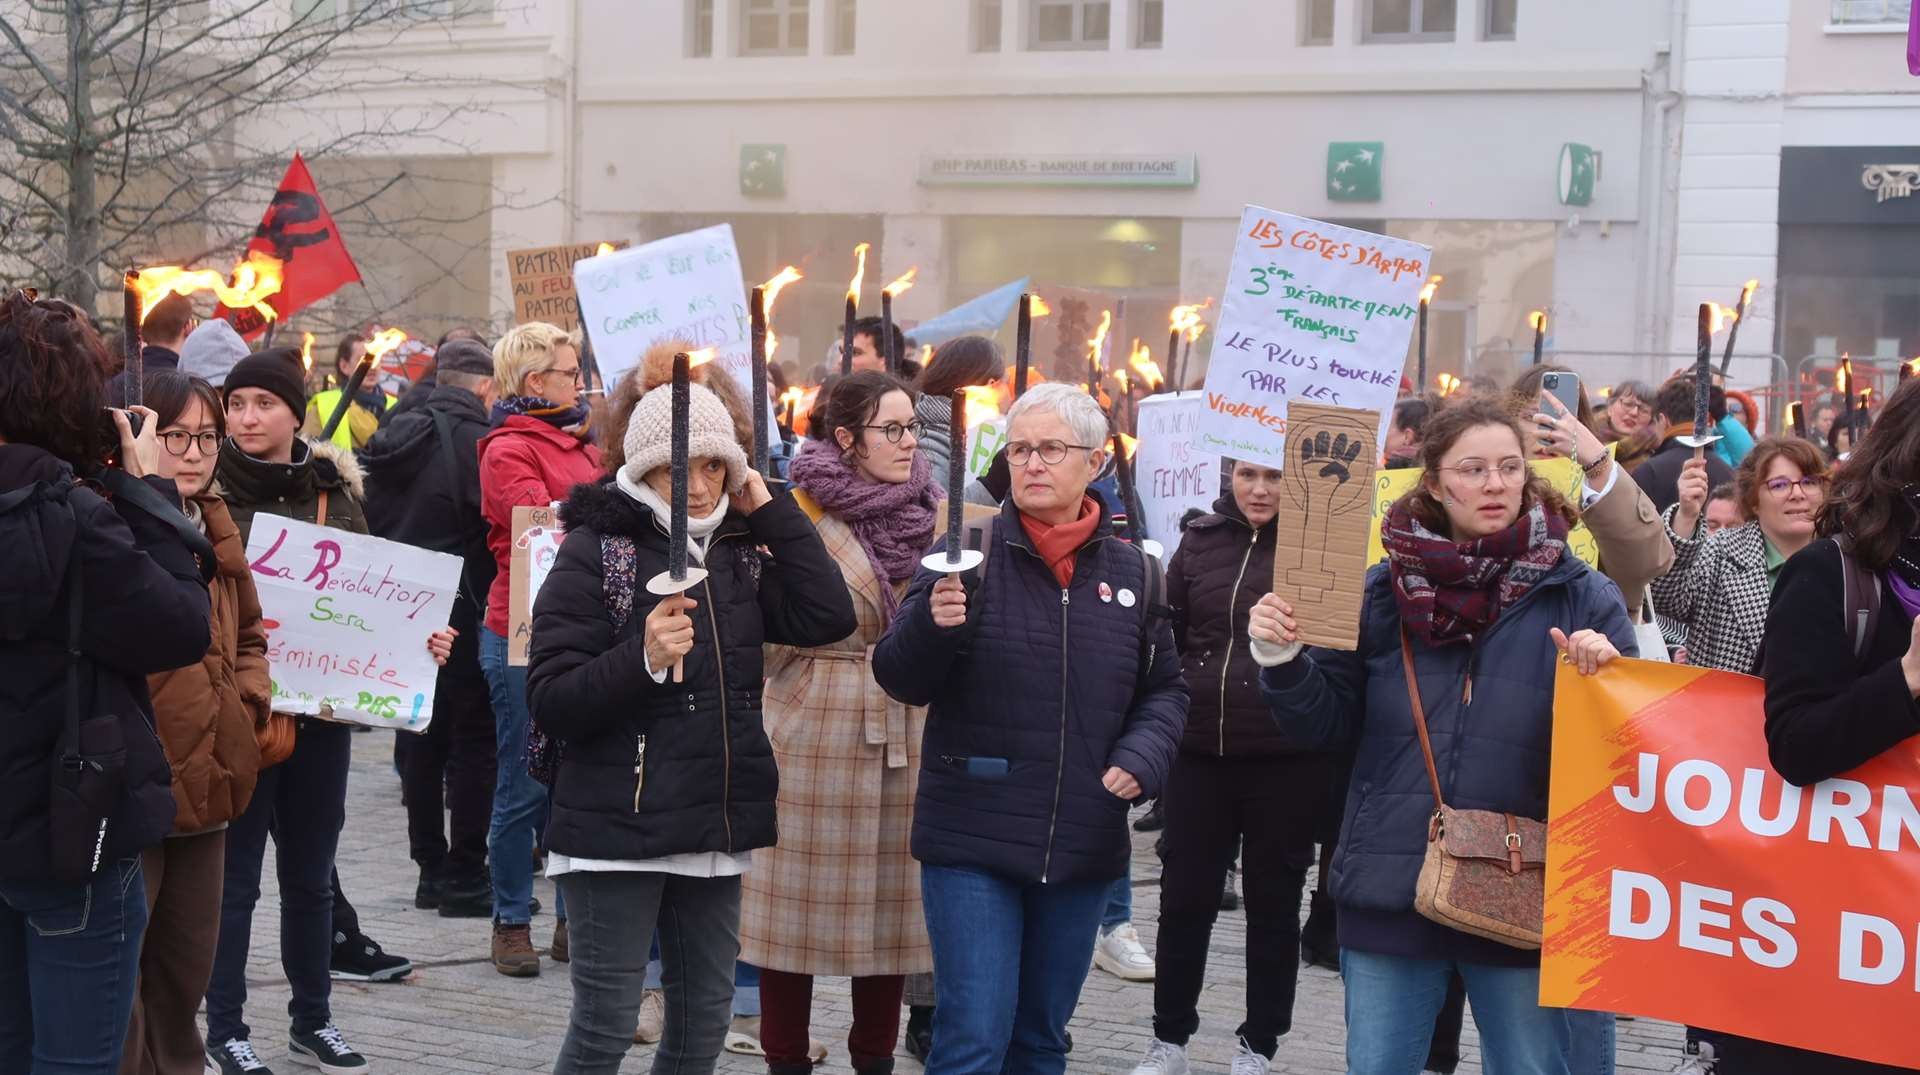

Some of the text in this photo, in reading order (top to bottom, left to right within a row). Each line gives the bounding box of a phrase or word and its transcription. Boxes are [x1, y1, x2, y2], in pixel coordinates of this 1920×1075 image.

[932, 159, 961, 172] BNP
[964, 159, 1027, 171] PARIBAS
[1040, 160, 1088, 172] BANQUE
[1093, 160, 1107, 171] DE
[1111, 160, 1177, 172] BRETAGNE
[1248, 218, 1424, 282] LES CÔTES D'ARMOR
[515, 276, 572, 297] AU FEU
[1280, 284, 1418, 321] DÉPARTEMENT
[525, 297, 577, 319] PATRO
[1225, 331, 1256, 352] LE
[1263, 342, 1319, 370] PLUS
[1242, 369, 1287, 395] PAR
[1153, 462, 1209, 499] FEMME
[250, 528, 294, 580] La
[309, 597, 374, 632] Sera
[91, 829, 106, 873] Profoto
[1608, 868, 1920, 993] DES D
